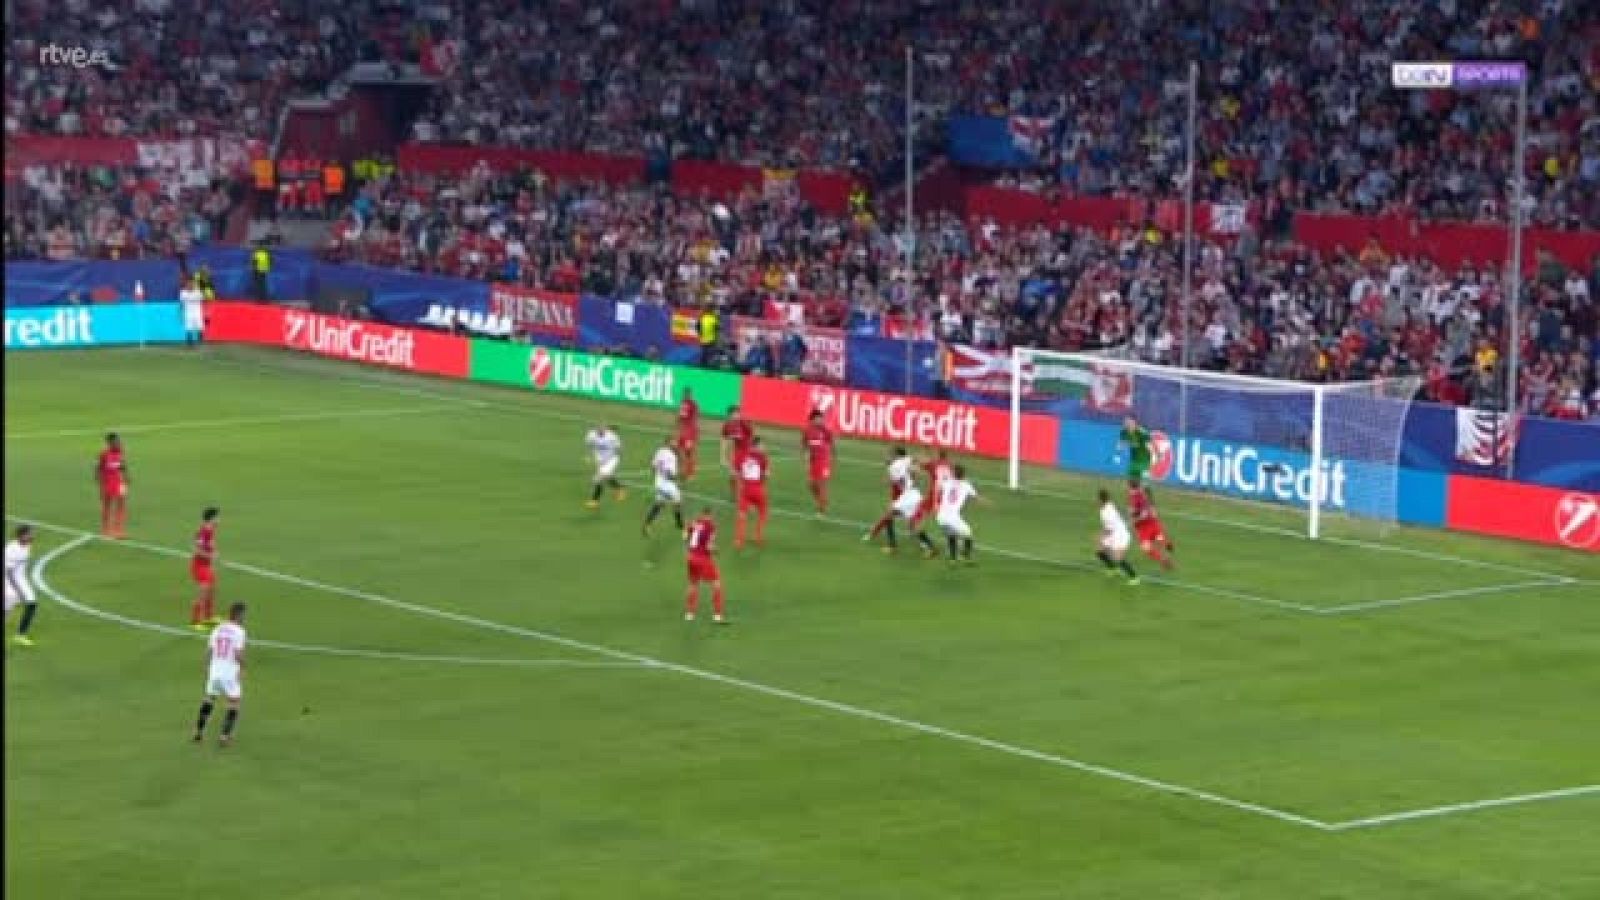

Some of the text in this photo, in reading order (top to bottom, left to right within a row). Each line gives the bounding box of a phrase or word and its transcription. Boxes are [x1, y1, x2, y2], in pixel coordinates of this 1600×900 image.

[5, 306, 92, 345] redit
[309, 304, 415, 368] UniCredit
[554, 352, 674, 405] UniCredit
[839, 390, 977, 450] UniCredit
